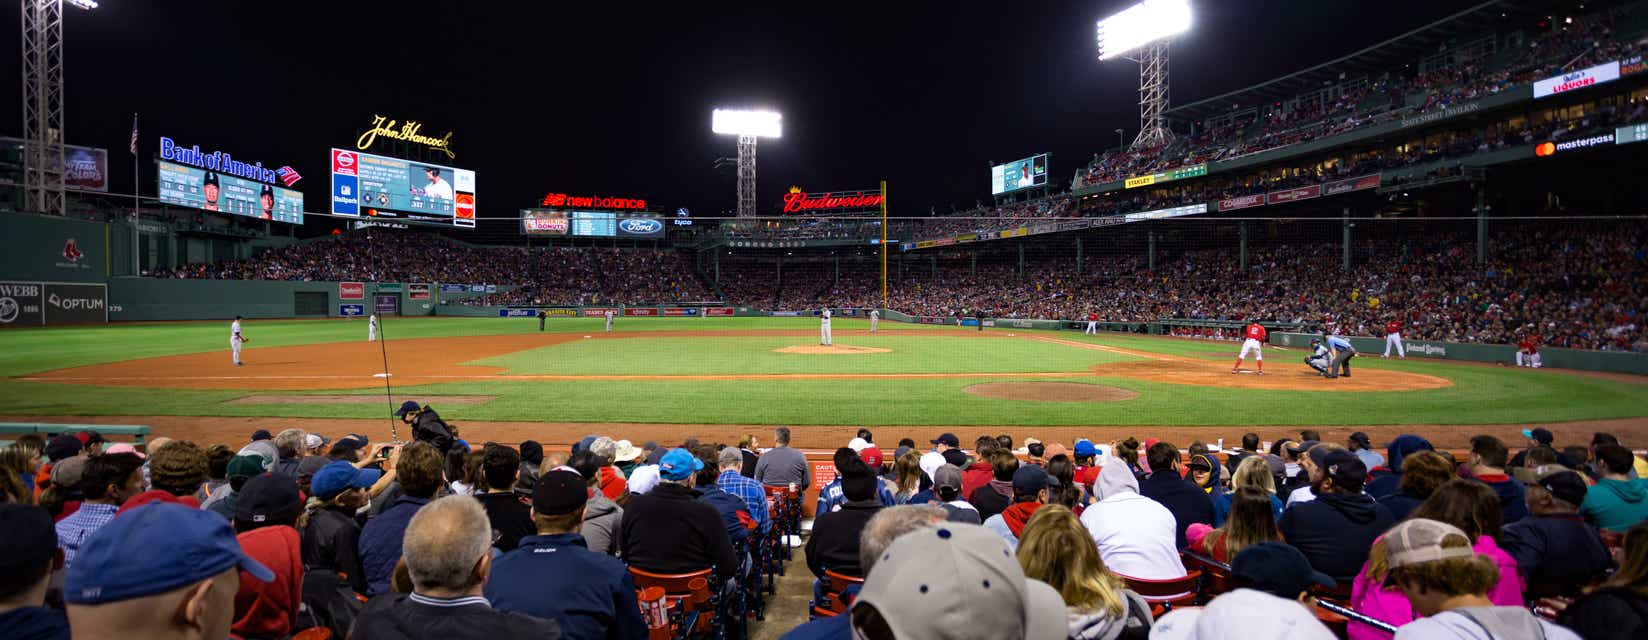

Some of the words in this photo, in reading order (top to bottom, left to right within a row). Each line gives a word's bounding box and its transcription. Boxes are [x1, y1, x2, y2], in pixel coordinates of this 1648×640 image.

[1552, 77, 1596, 94] LIQUORS
[356, 113, 399, 150] John
[401, 120, 456, 160] Hancock
[1556, 133, 1615, 151] masterpass
[160, 136, 205, 169] Bank
[205, 150, 221, 171] of
[221, 152, 276, 185] America
[1127, 177, 1150, 188] STANLEY
[566, 196, 593, 207] new
[594, 195, 645, 209] balance
[783, 191, 885, 213] Budweiser
[627, 219, 653, 232] Ford
[62, 299, 103, 309] OPTUM
[1406, 342, 1425, 352] Poland
[1425, 343, 1446, 355] Spring
